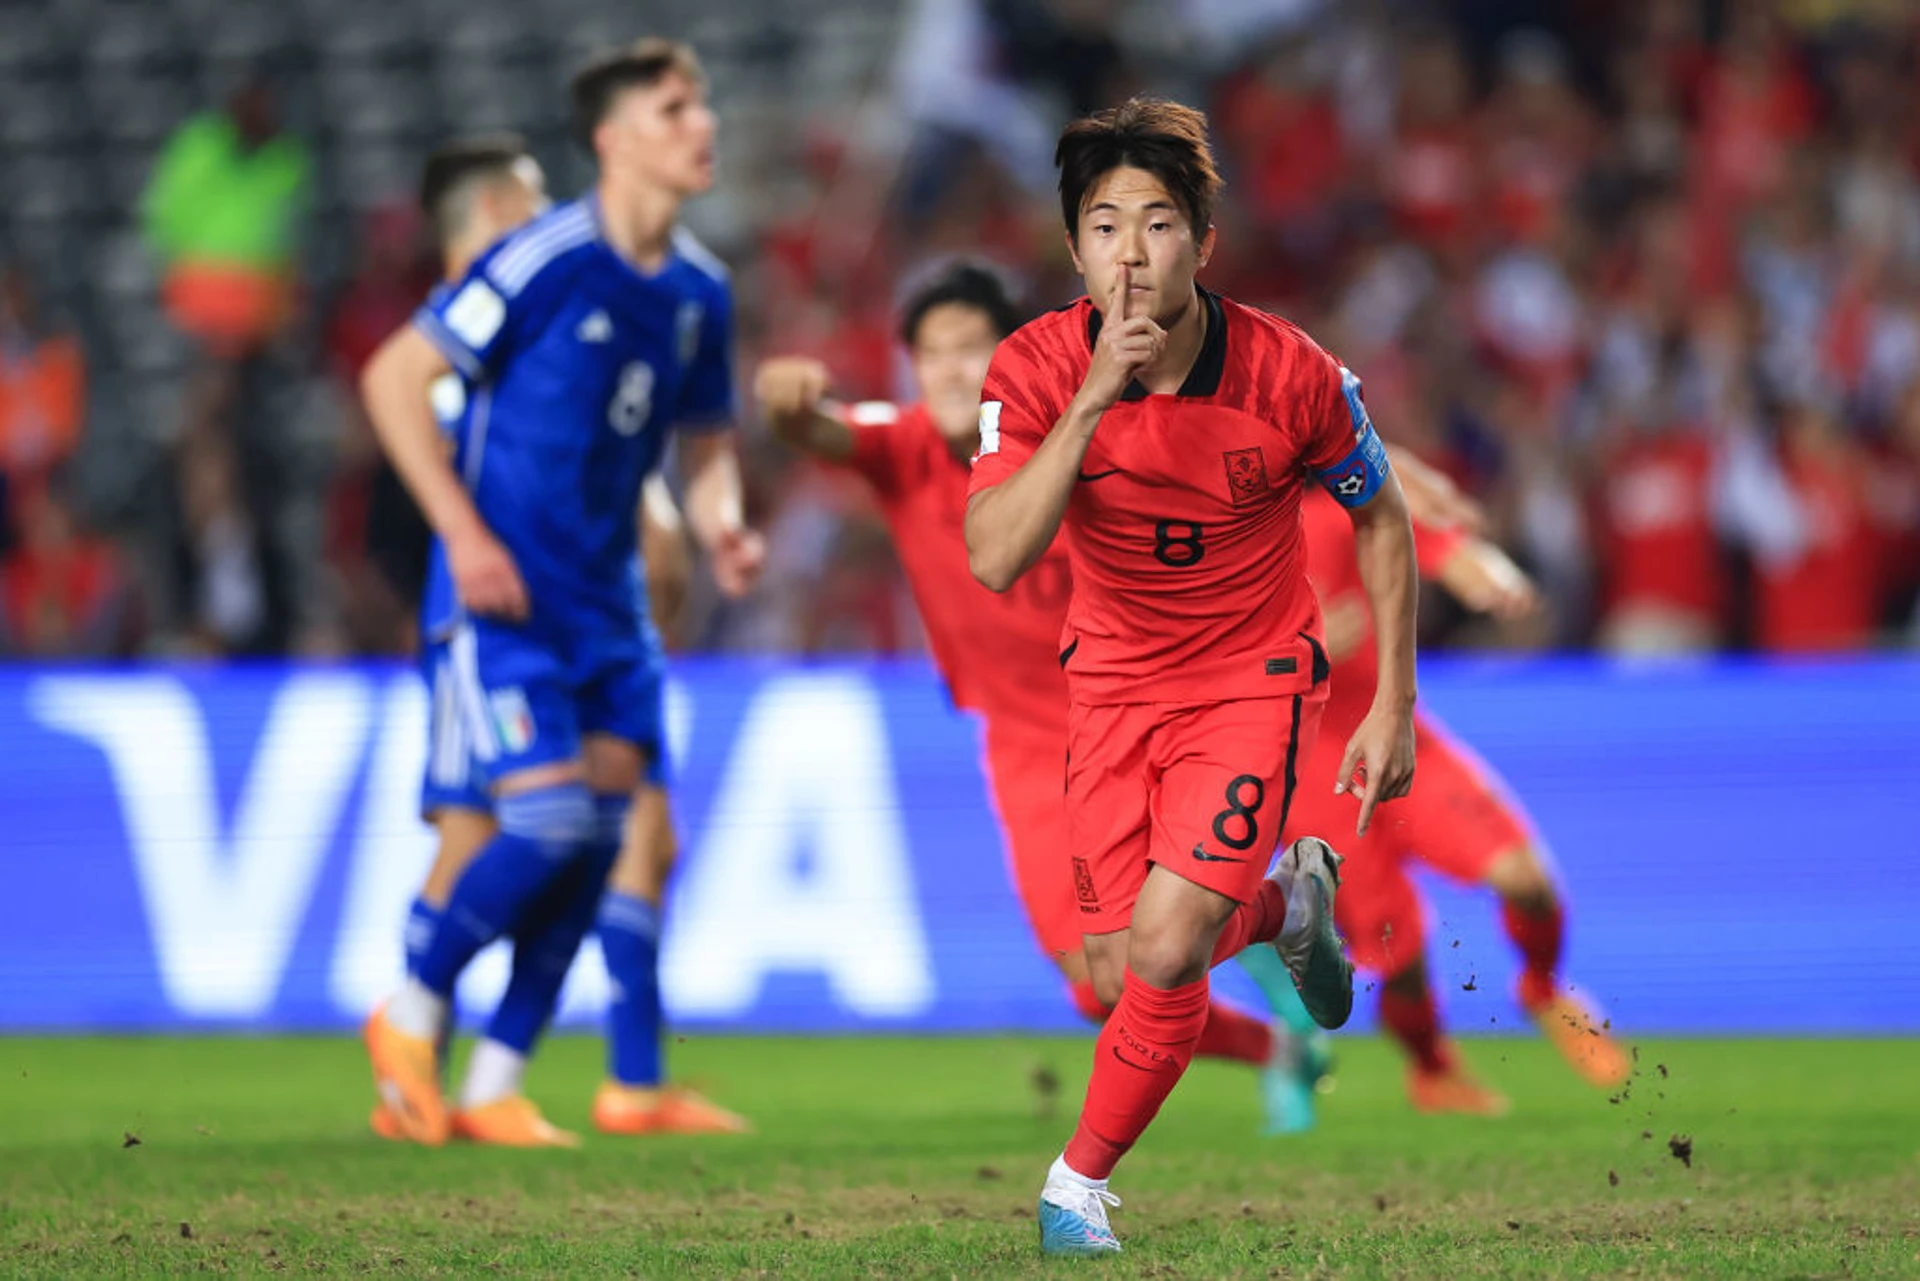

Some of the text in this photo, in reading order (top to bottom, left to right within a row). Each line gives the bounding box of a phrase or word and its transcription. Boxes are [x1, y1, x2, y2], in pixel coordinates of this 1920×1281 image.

[607, 360, 655, 437] 8
[1154, 518, 1205, 568] 8
[28, 674, 938, 1019] VIA
[1212, 774, 1264, 850] 8
